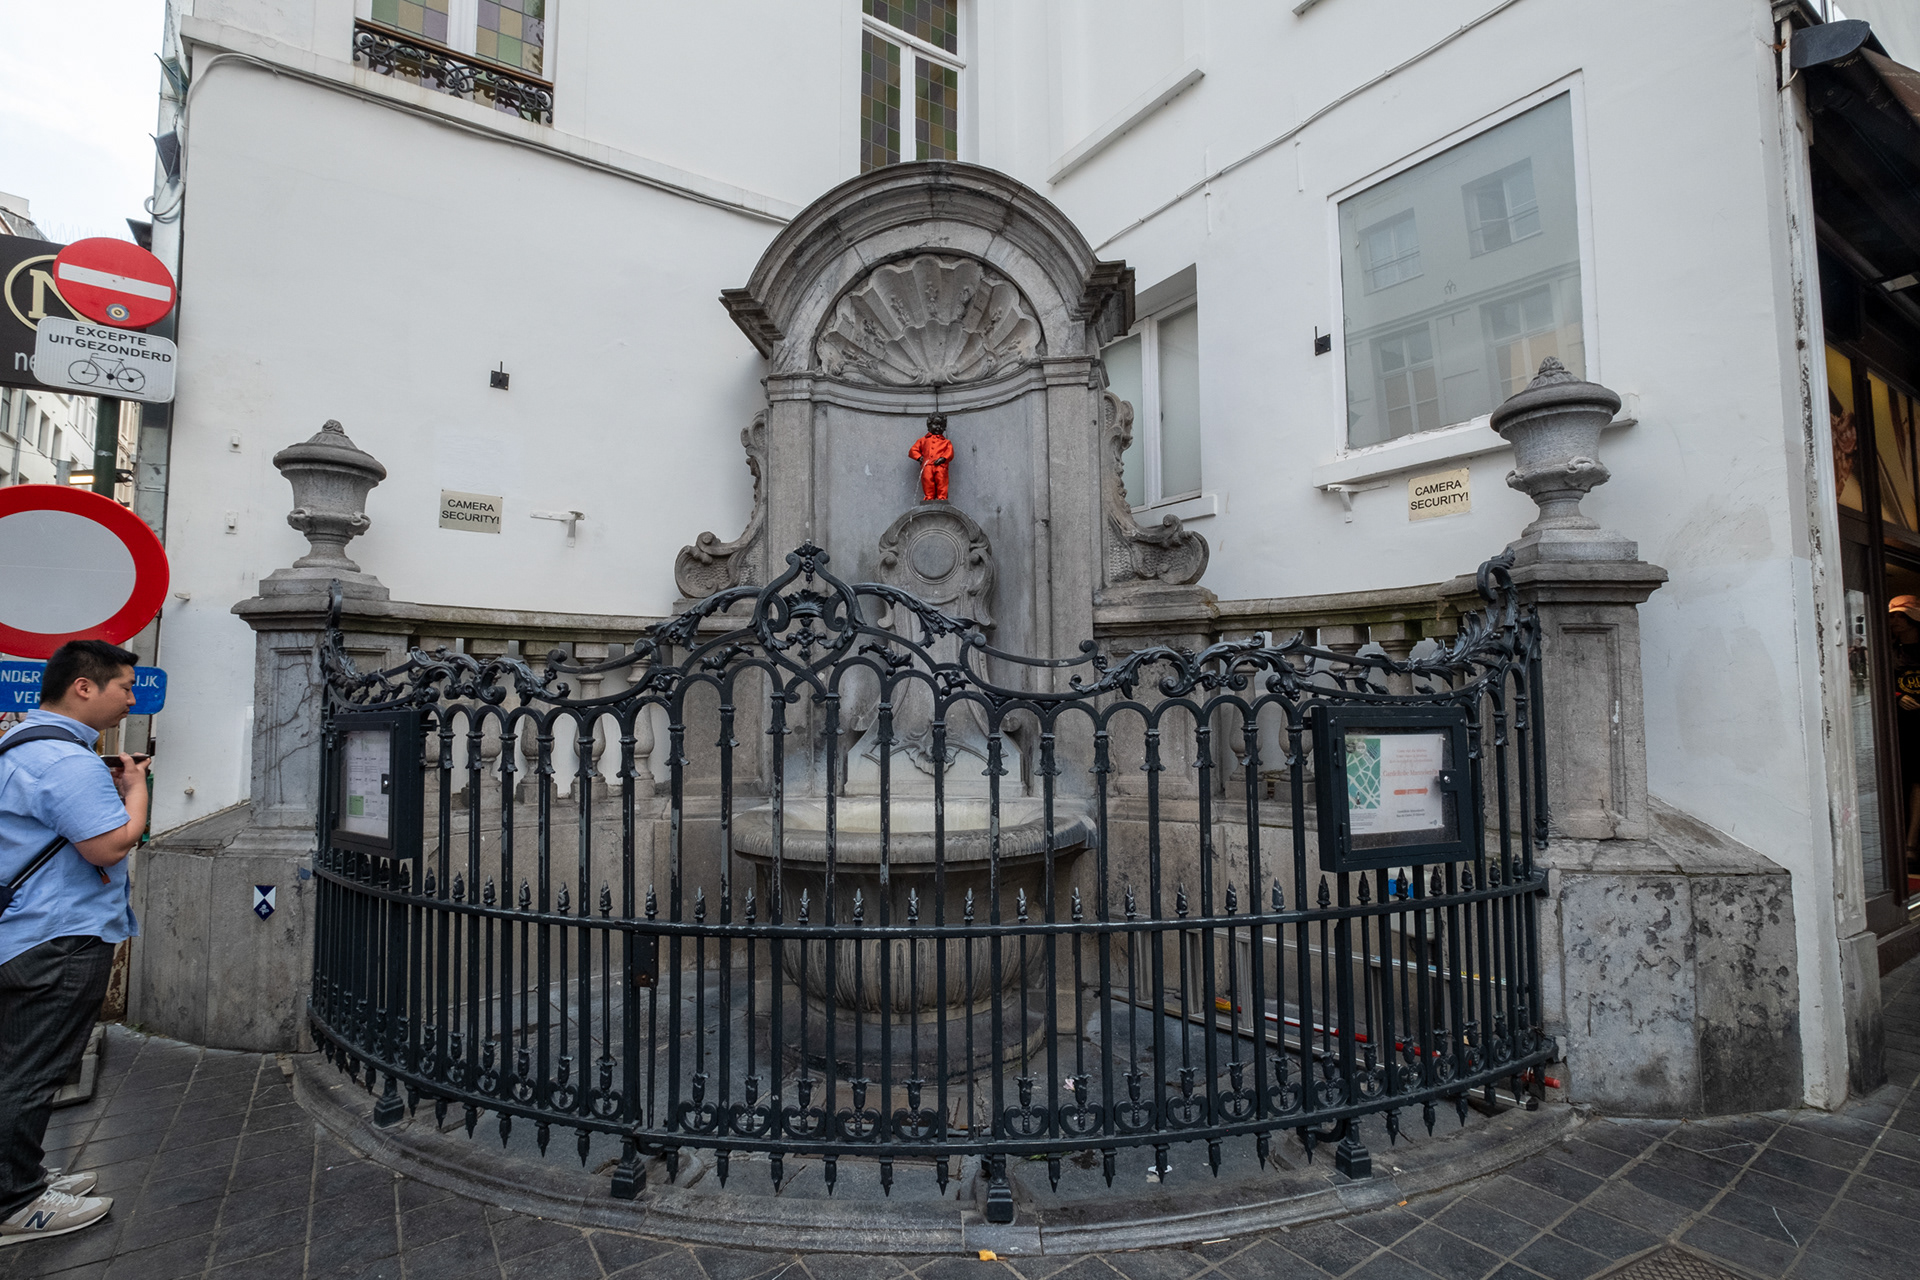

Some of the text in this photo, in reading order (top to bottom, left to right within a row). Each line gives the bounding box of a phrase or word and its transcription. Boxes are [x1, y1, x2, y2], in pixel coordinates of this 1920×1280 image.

[75, 325, 147, 347] EXCEPTE
[48, 333, 172, 363] UITGEZONDERD
[1415, 479, 1462, 497] CAMERA
[447, 499, 495, 512] CAMERA
[1410, 492, 1469, 511] SECURITY!
[441, 510, 500, 525] SECURITY!
[132, 674, 160, 689] IJK
[23, 1210, 56, 1230] N
